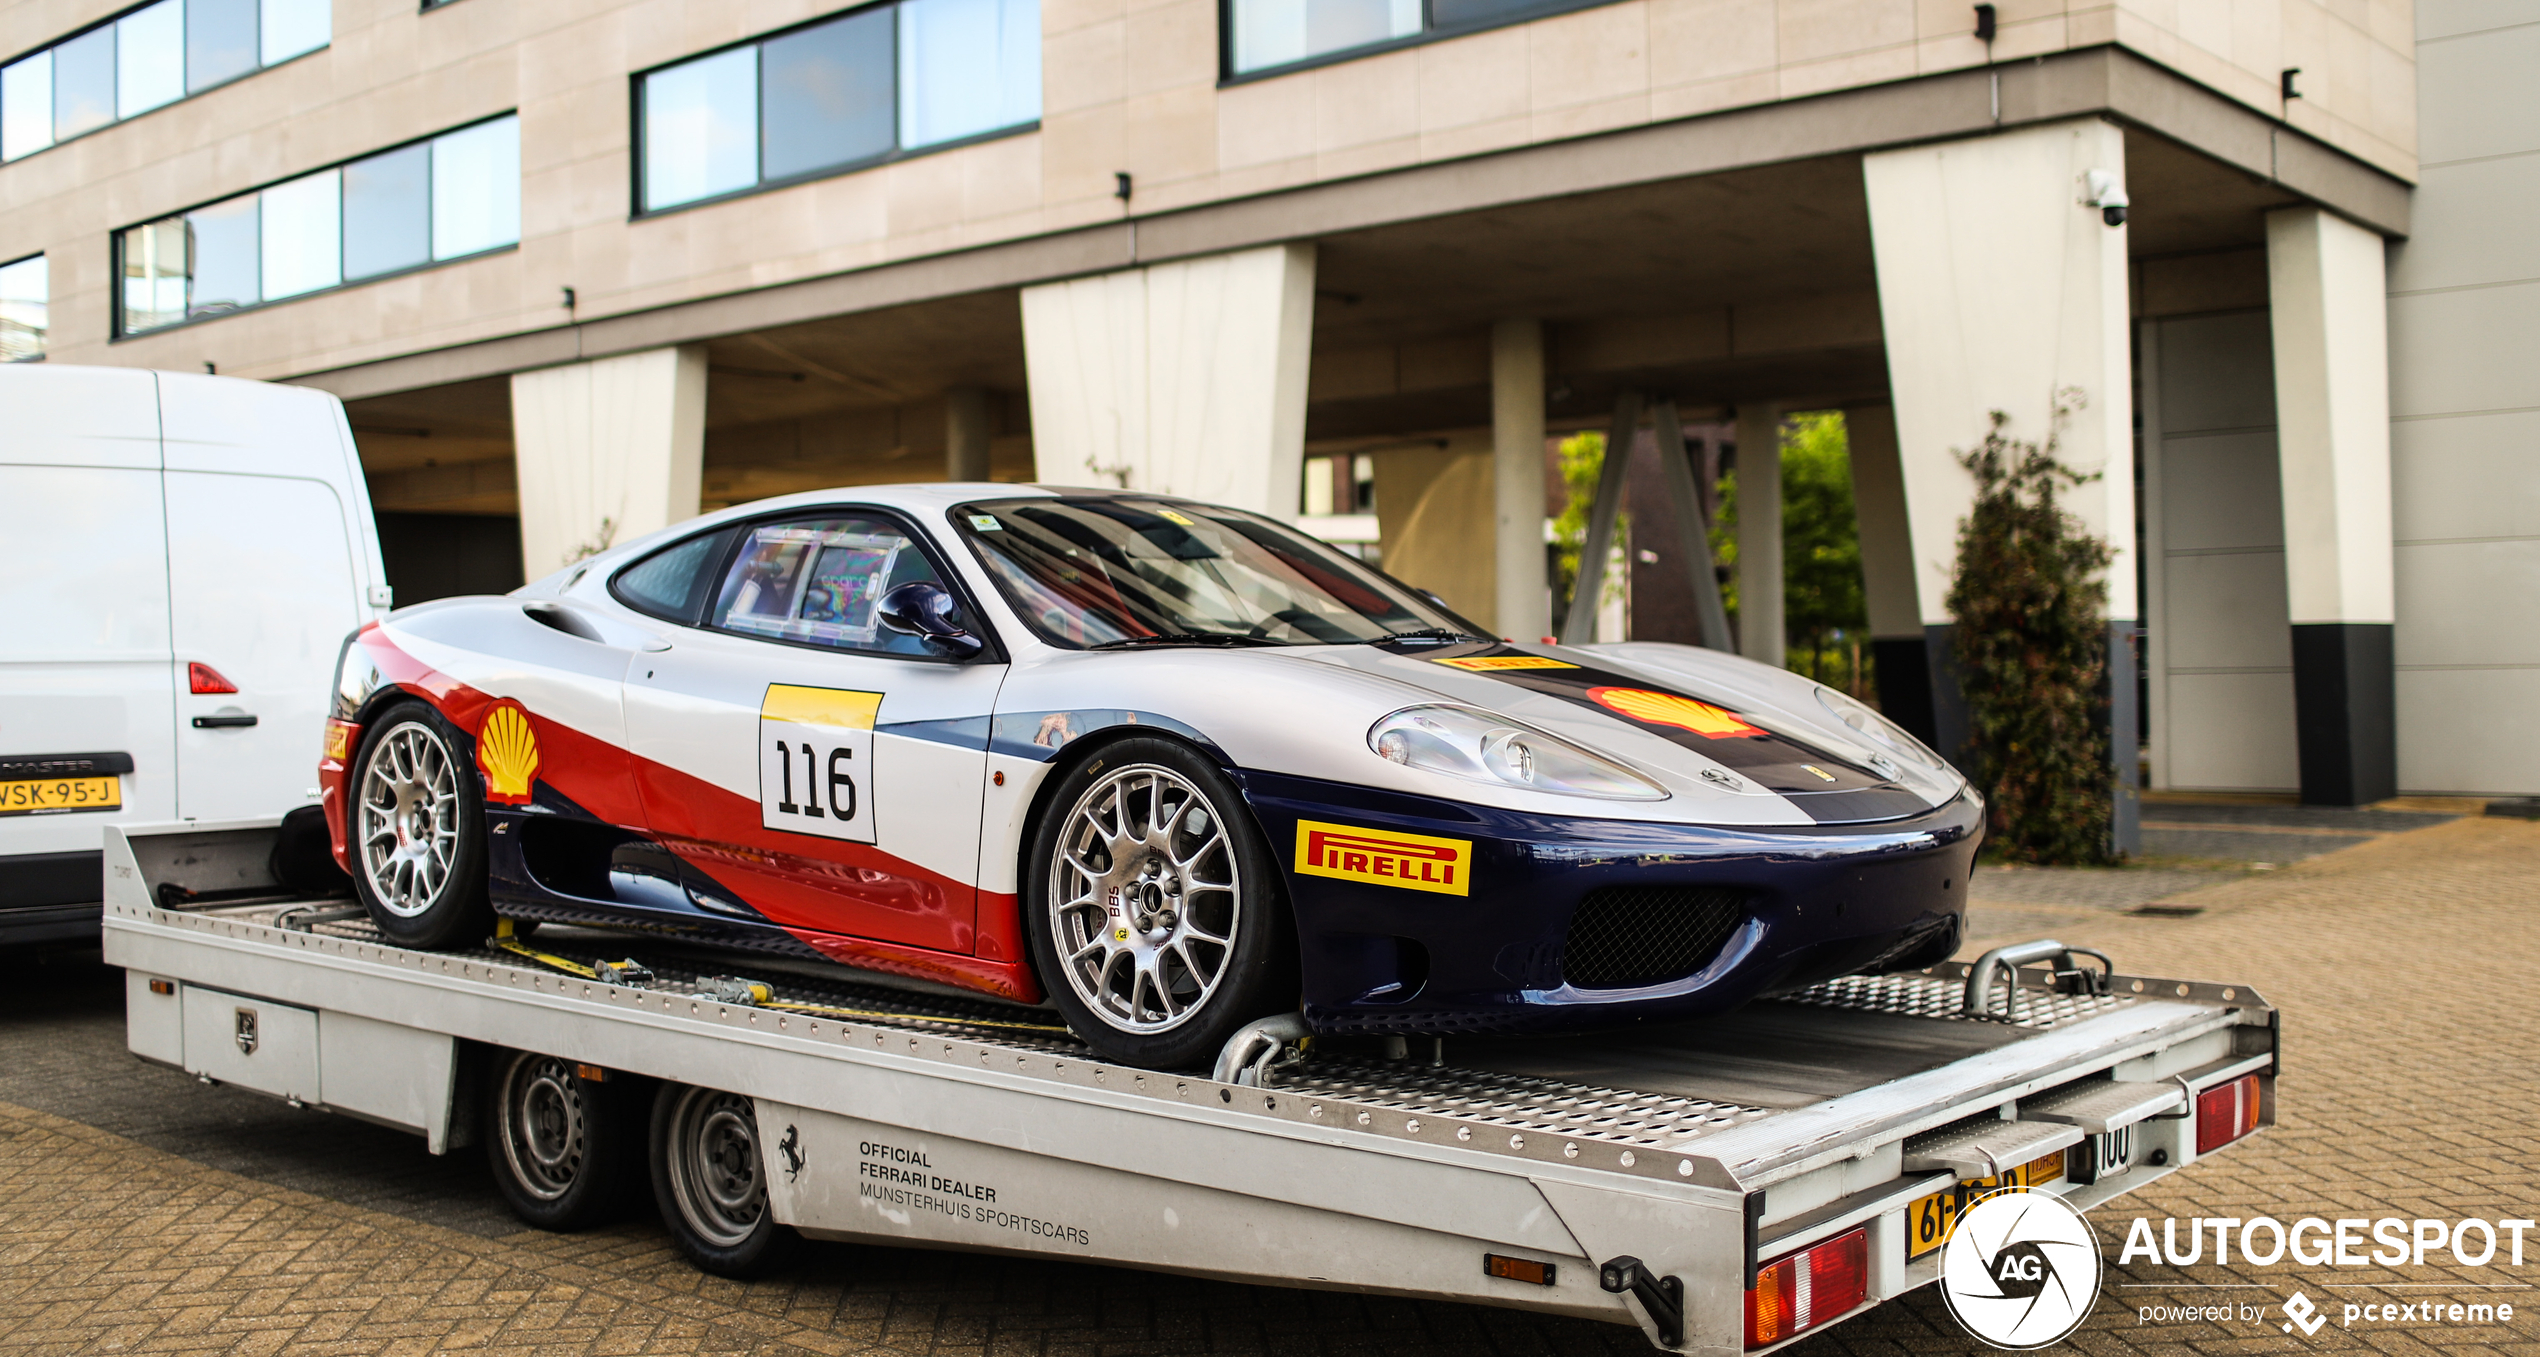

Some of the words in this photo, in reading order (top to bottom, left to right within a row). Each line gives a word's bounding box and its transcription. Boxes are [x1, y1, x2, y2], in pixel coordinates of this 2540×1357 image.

[2, 760, 94, 773] MASTER
[777, 740, 857, 823] 116
[1307, 830, 1458, 885] PIRELLI
[1108, 885, 1121, 917] BBS
[859, 1141, 932, 1169] OFFICIAL
[859, 1161, 927, 1189] FERRARI
[931, 1176, 997, 1204] DEALER
[859, 1181, 971, 1219] MUNSTERHUIS
[975, 1207, 1090, 1246] SPORTSCARS
